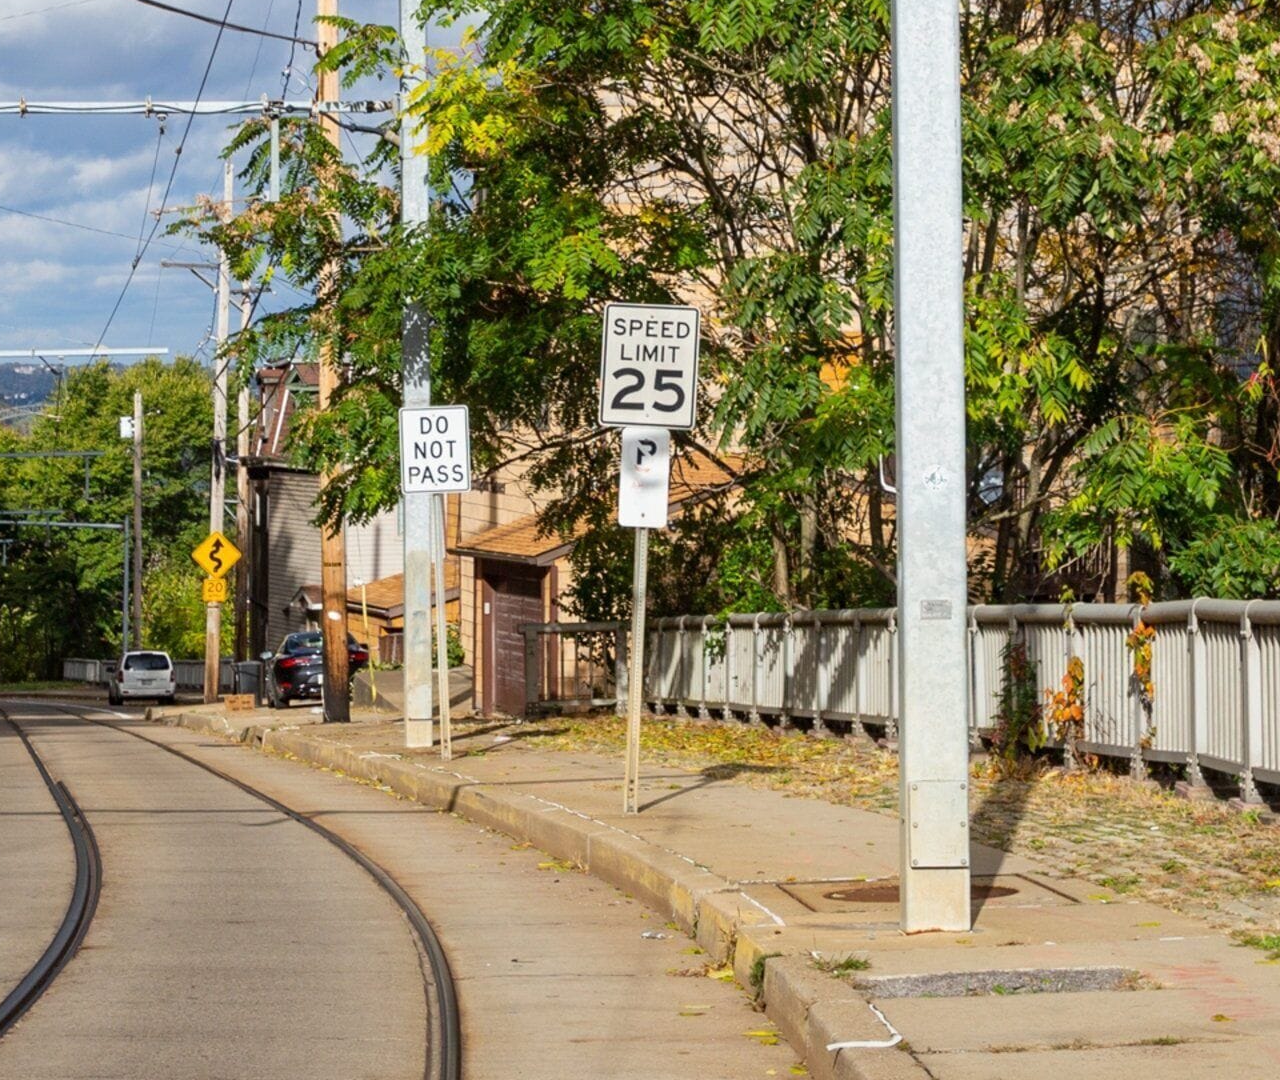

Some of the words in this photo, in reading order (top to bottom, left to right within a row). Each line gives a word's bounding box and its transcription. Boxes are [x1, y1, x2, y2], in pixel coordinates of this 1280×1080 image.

[613, 318, 691, 339] SPEED
[620, 343, 680, 363] LIMIT
[610, 367, 686, 412] 25
[420, 415, 449, 435] DO
[414, 440, 456, 459] NOT
[408, 464, 464, 484] PASS
[208, 582, 223, 593] 20
